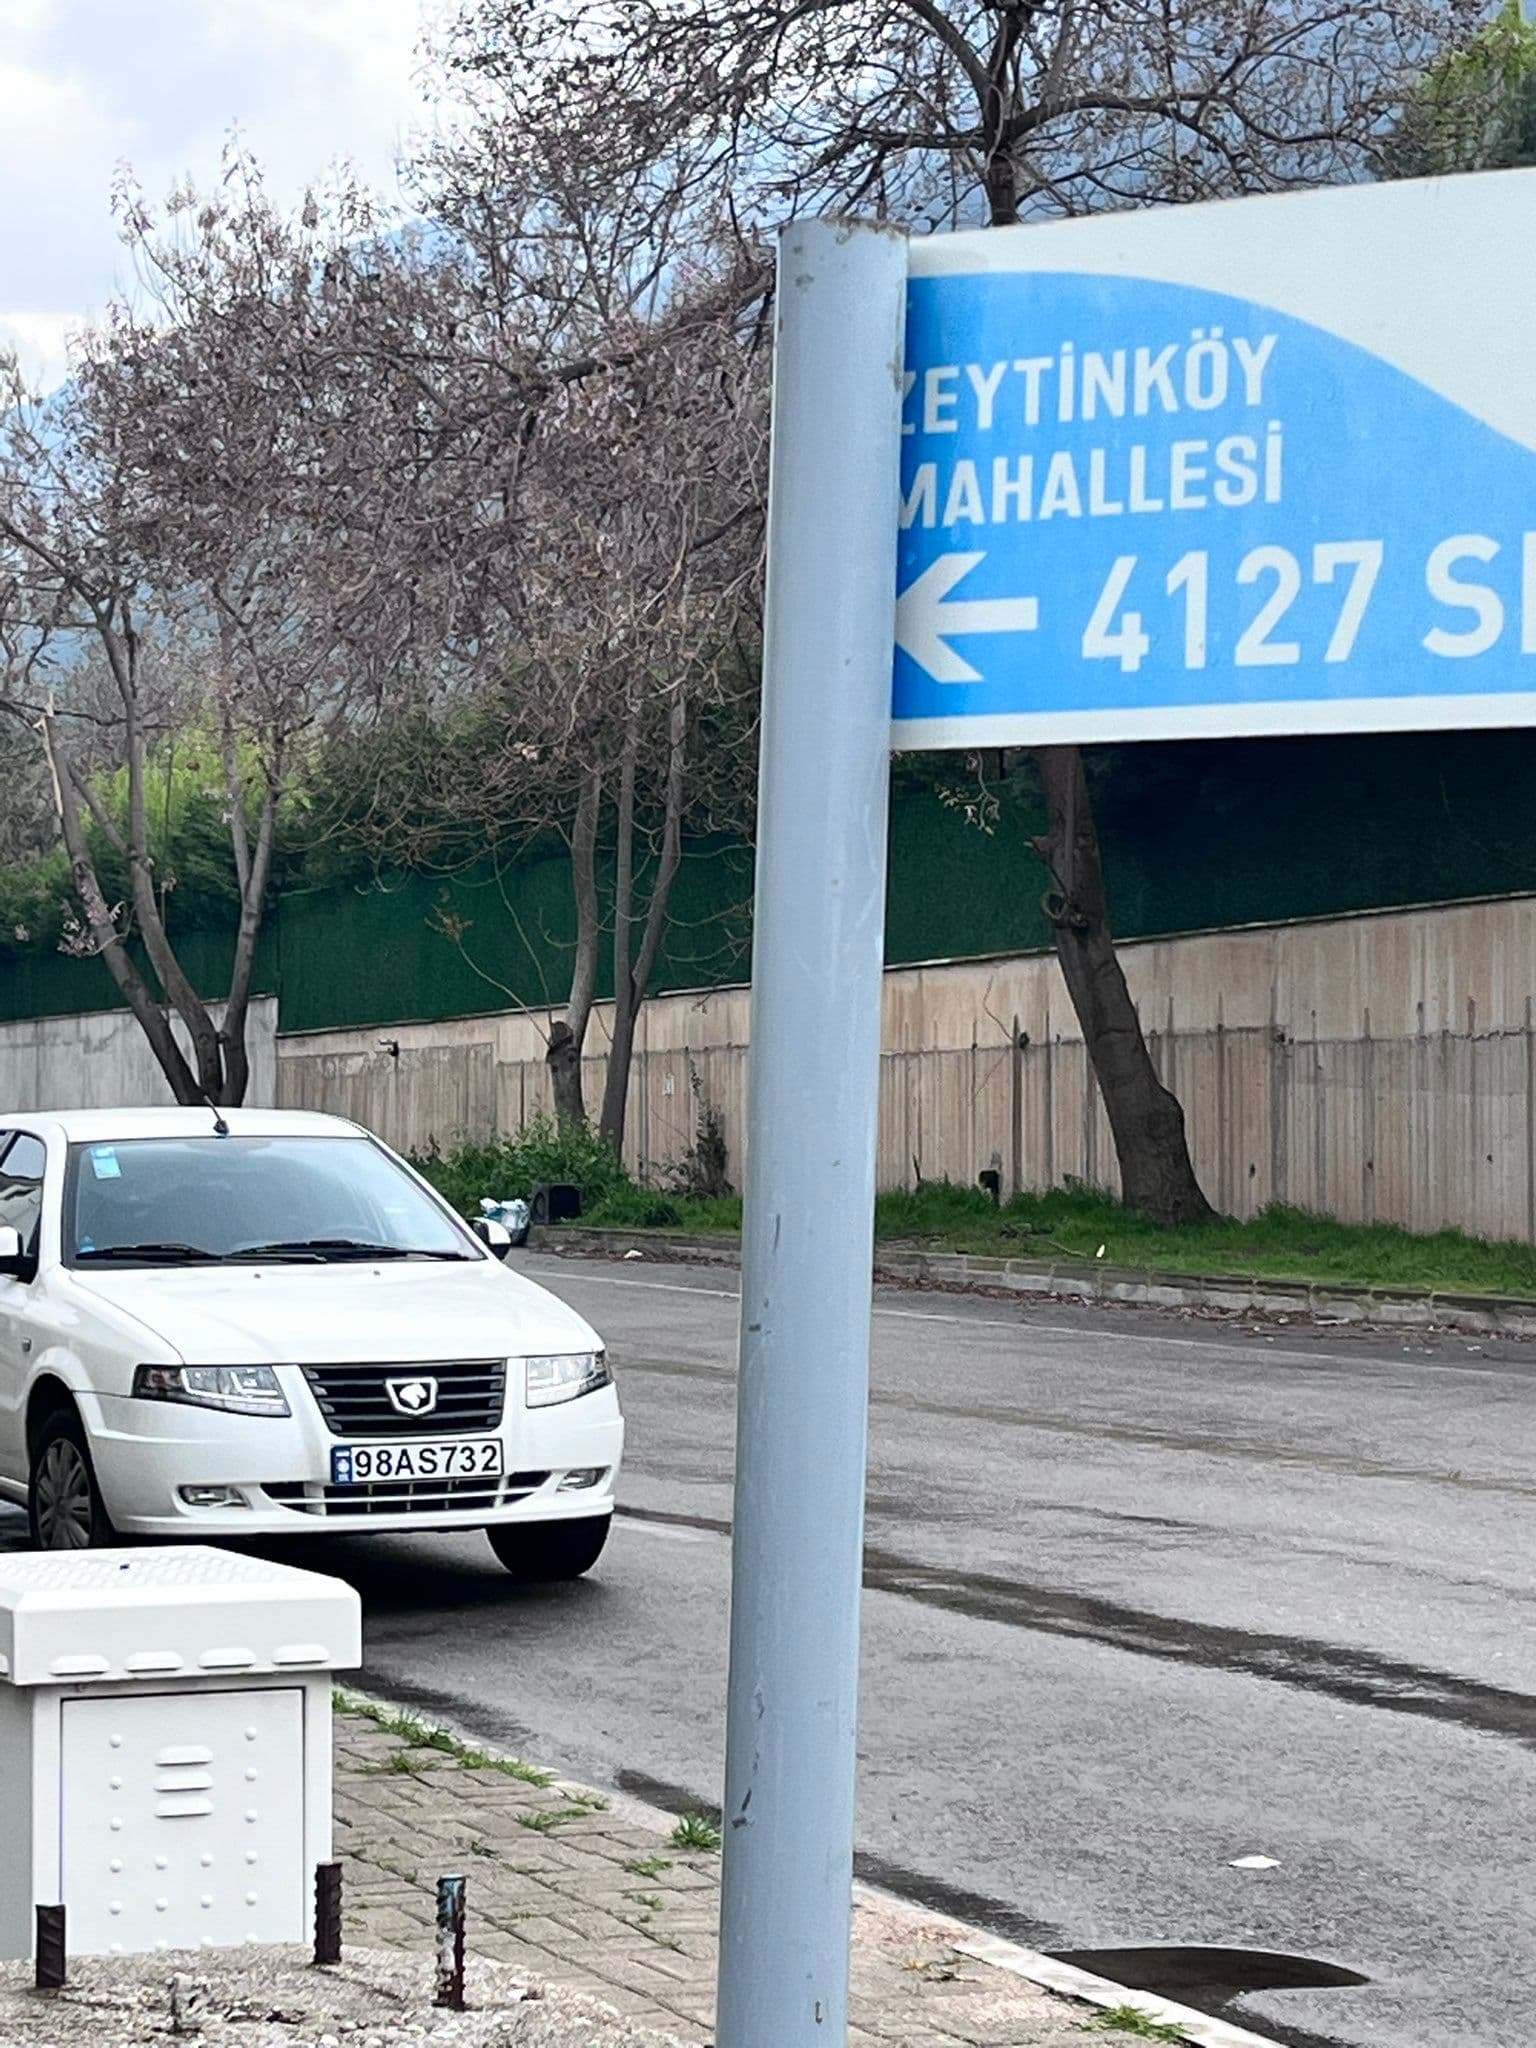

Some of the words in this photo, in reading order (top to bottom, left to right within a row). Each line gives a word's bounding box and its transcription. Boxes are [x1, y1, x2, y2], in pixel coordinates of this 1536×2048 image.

[899, 421, 1283, 529] MAHALLESİ
[1081, 540, 1384, 672] 4127
[1422, 531, 1536, 658] S
[355, 1446, 498, 1477] 98AS732
